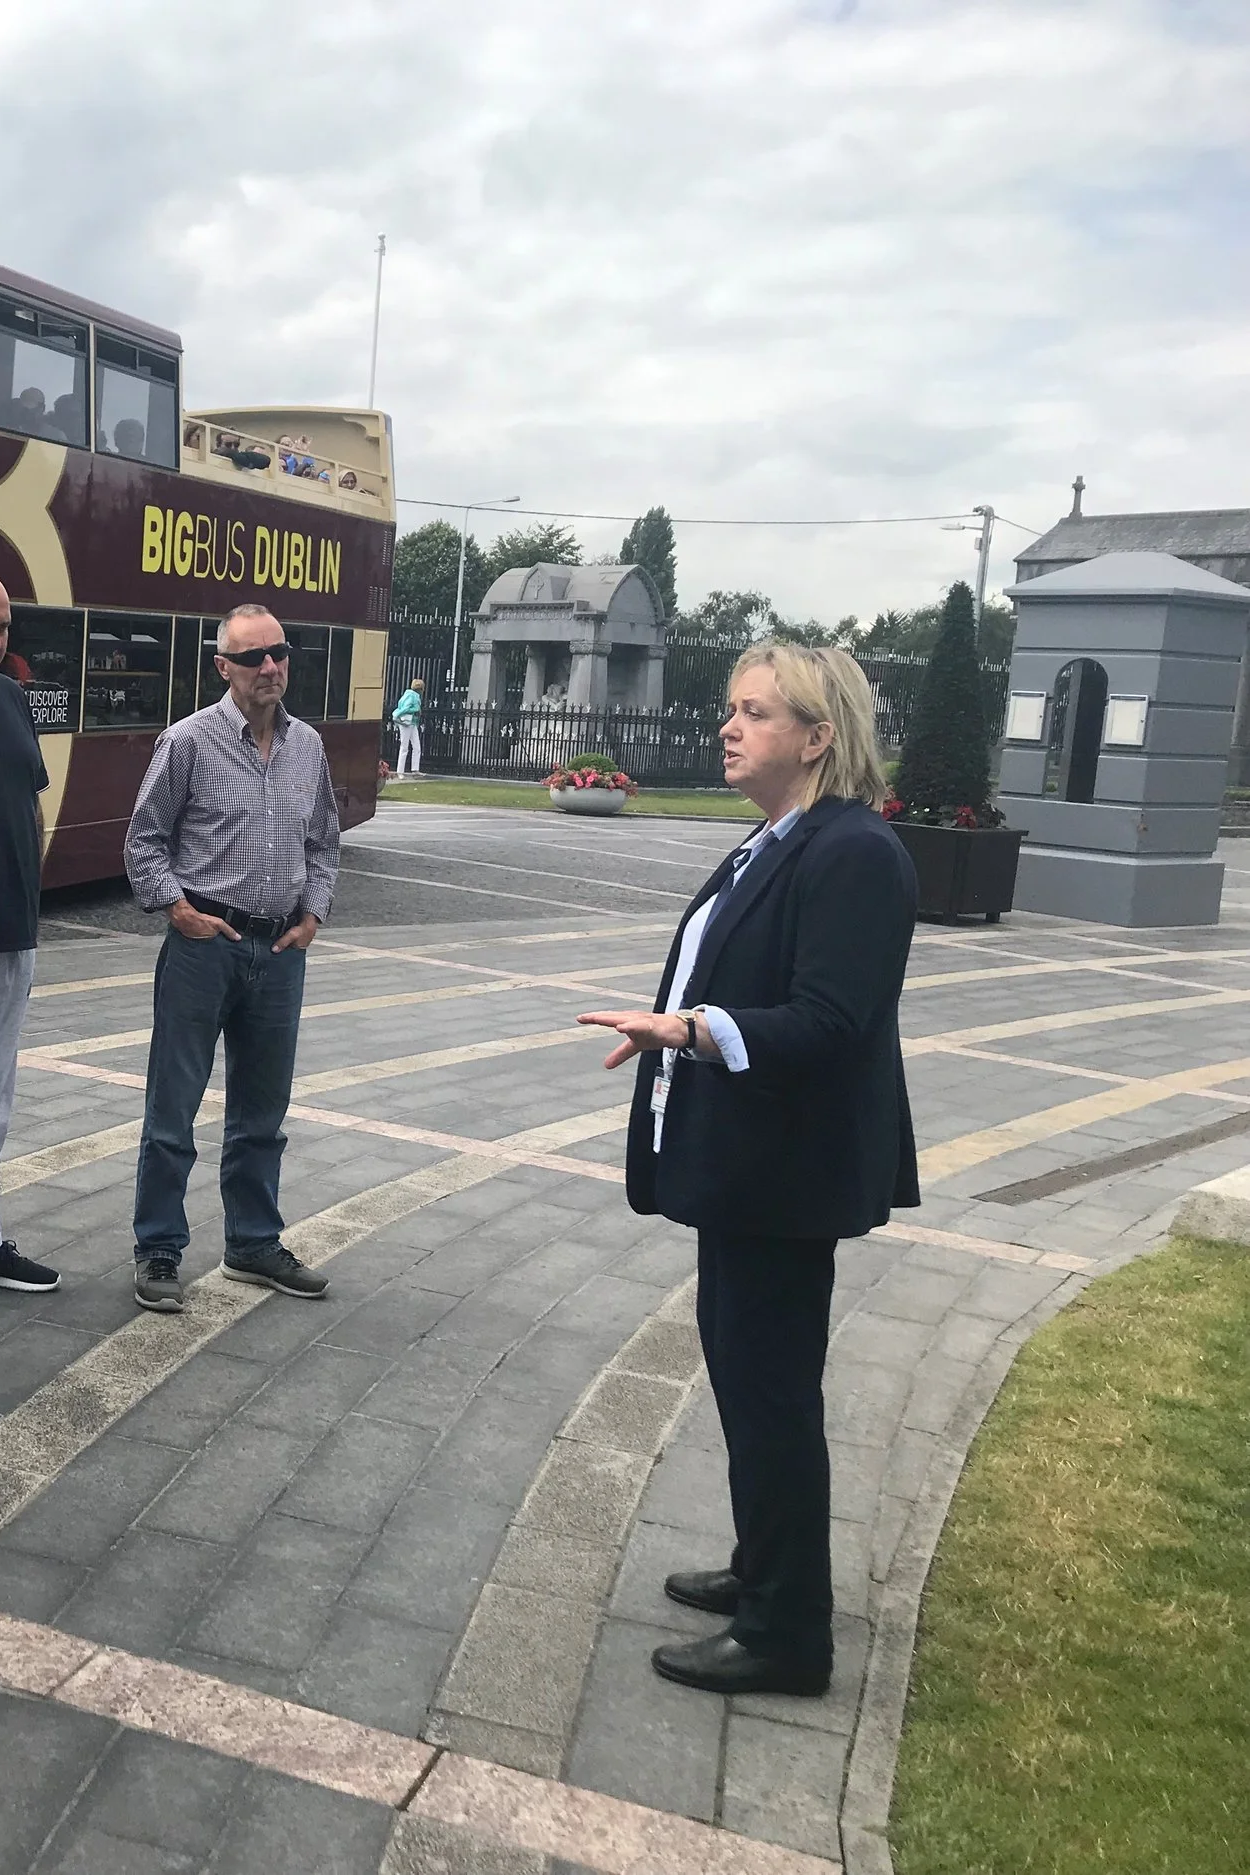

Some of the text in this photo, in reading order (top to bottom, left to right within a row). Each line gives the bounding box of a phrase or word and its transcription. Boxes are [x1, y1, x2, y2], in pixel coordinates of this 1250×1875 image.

[253, 525, 342, 595] DUBLIN
[29, 690, 69, 707] DISCOVER
[31, 707, 68, 724] EXPLORE
